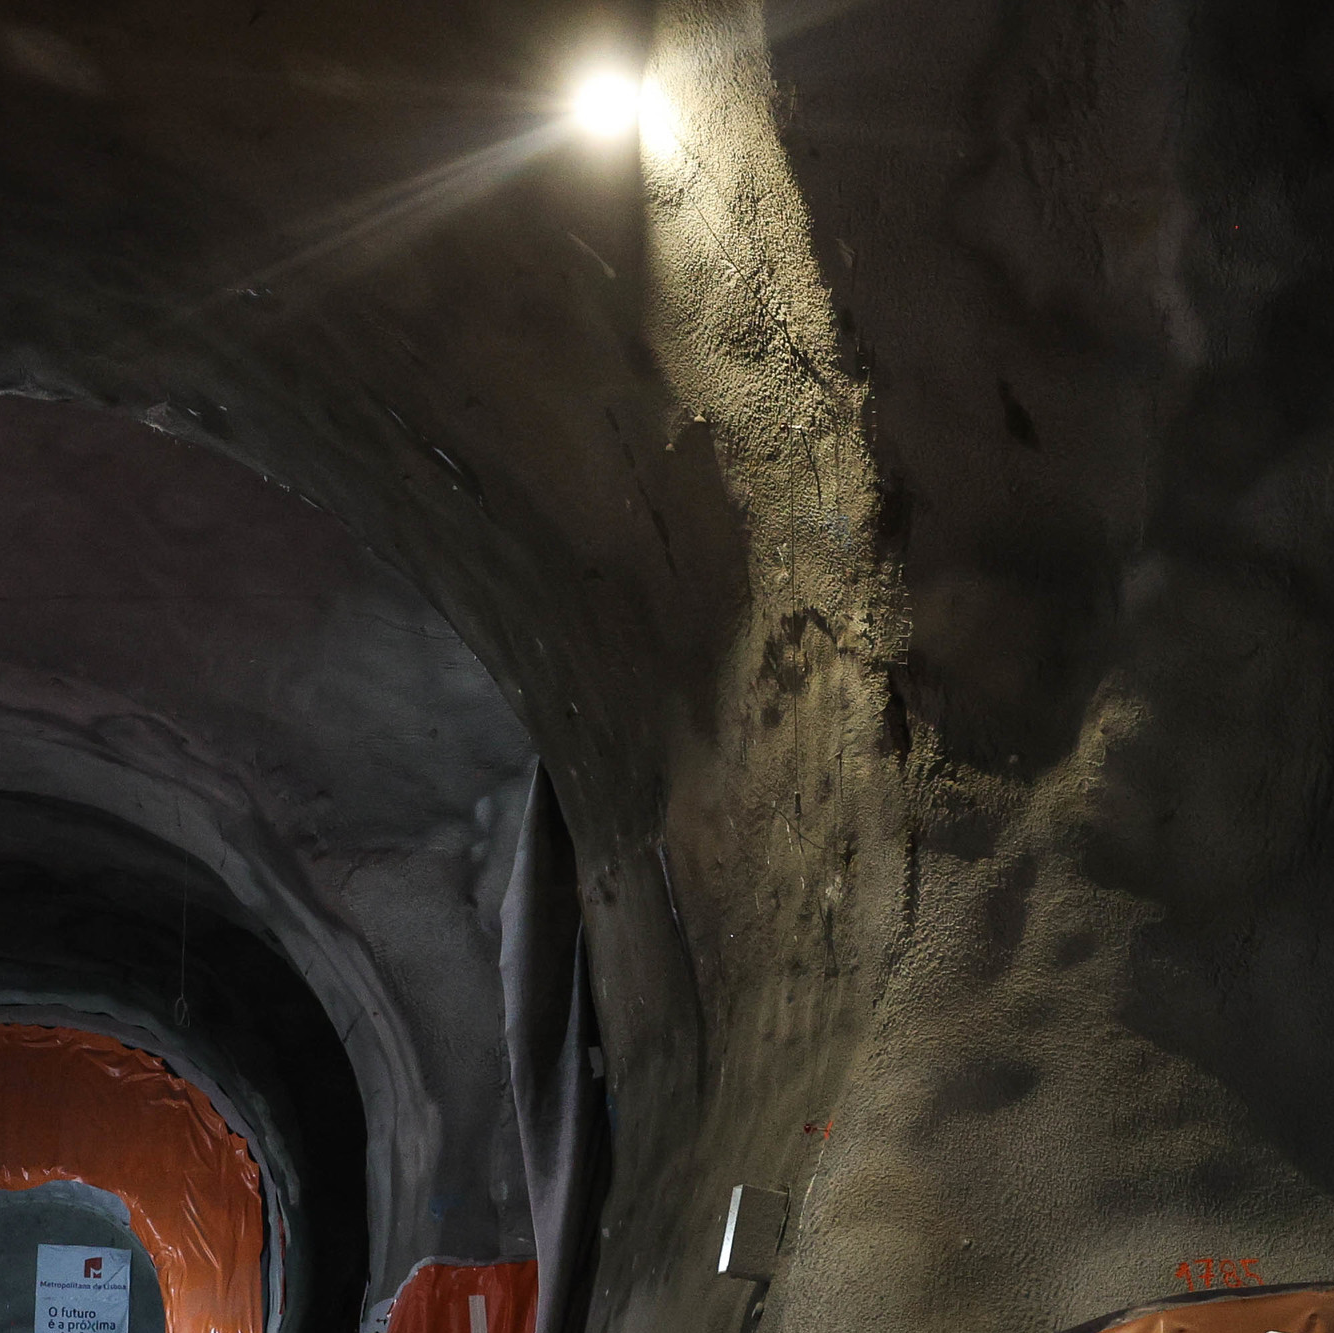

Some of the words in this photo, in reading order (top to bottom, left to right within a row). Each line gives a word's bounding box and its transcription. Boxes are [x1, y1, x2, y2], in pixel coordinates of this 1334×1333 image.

[1174, 1258, 1264, 1291] 1785
[92, 1281, 101, 1290] de
[48, 1306, 58, 1318] O
[61, 1306, 96, 1319] futuro
[48, 1318, 55, 1329] é
[58, 1321, 64, 1329] a
[68, 1319, 116, 1332] próxima
